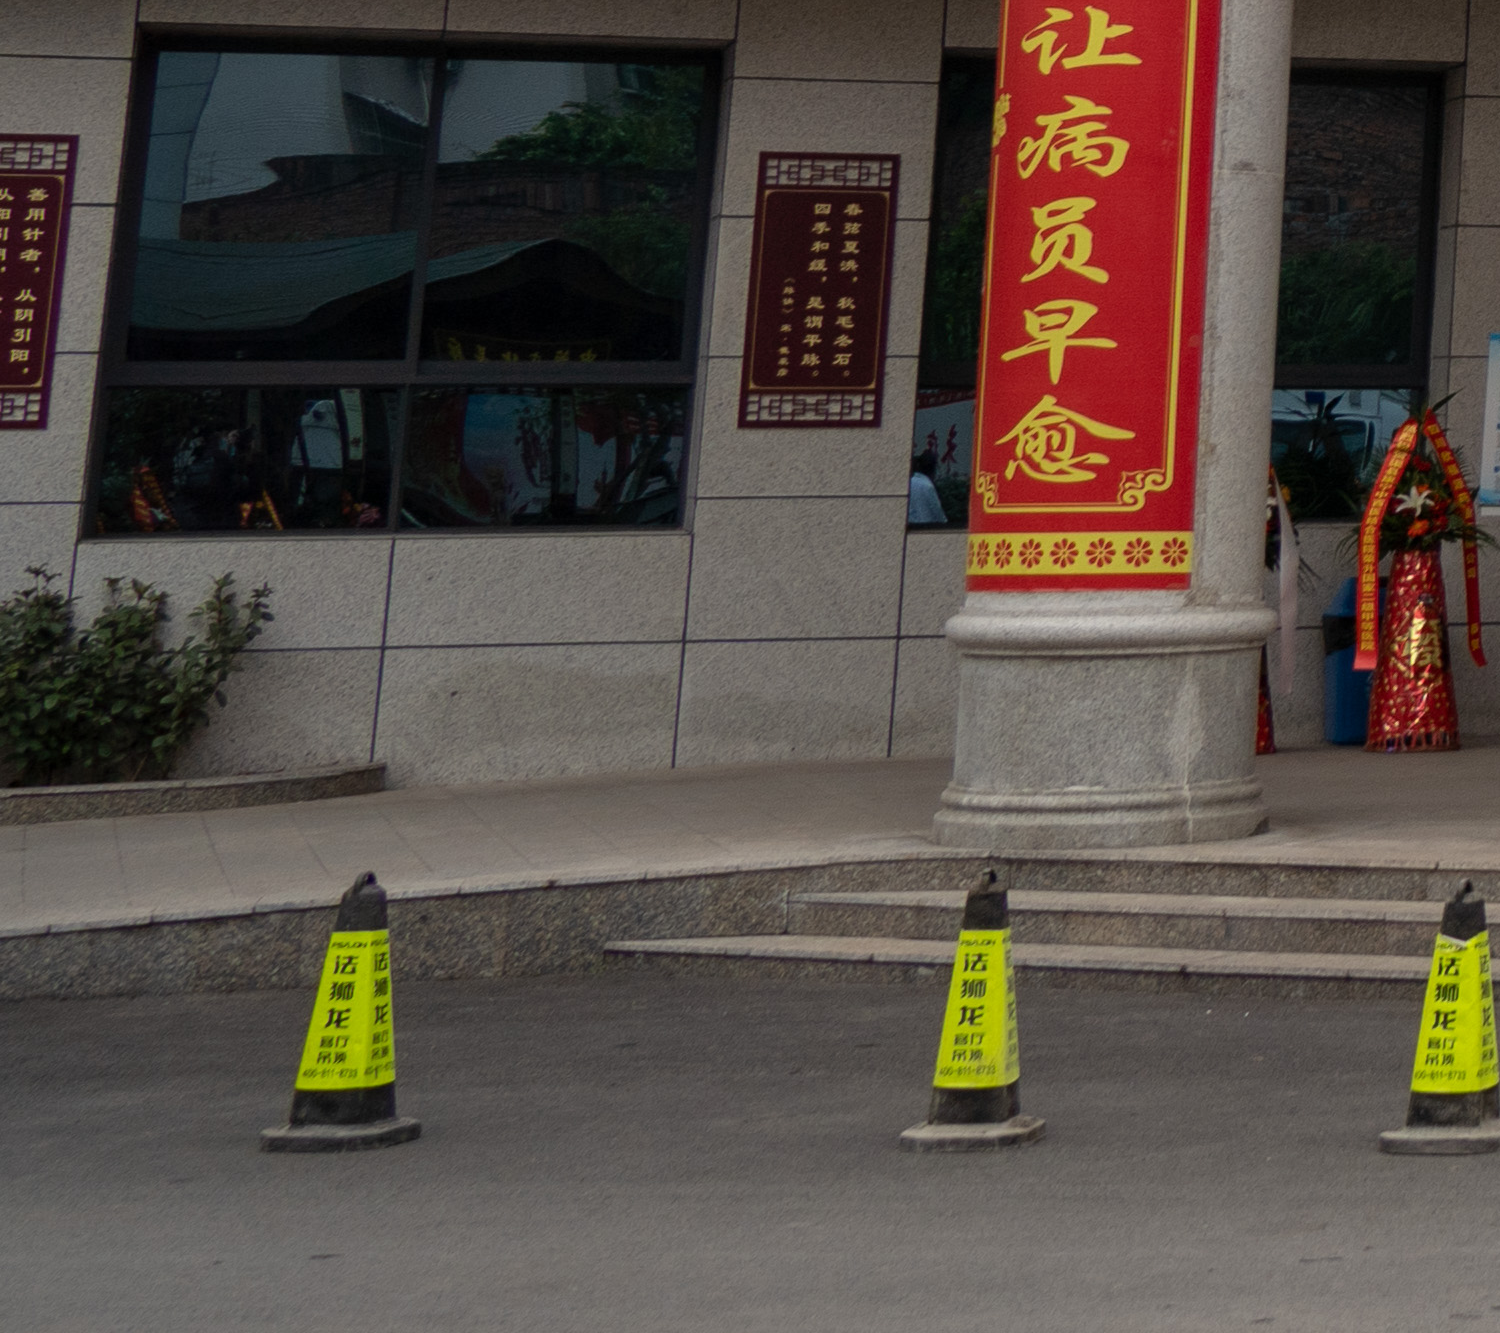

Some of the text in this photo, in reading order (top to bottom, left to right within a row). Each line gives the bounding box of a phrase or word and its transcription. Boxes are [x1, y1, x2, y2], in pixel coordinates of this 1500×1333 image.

[323, 954, 360, 1030] 法狮龙
[958, 952, 990, 1029] 法狮龙
[1433, 956, 1462, 1031] 法狮龙
